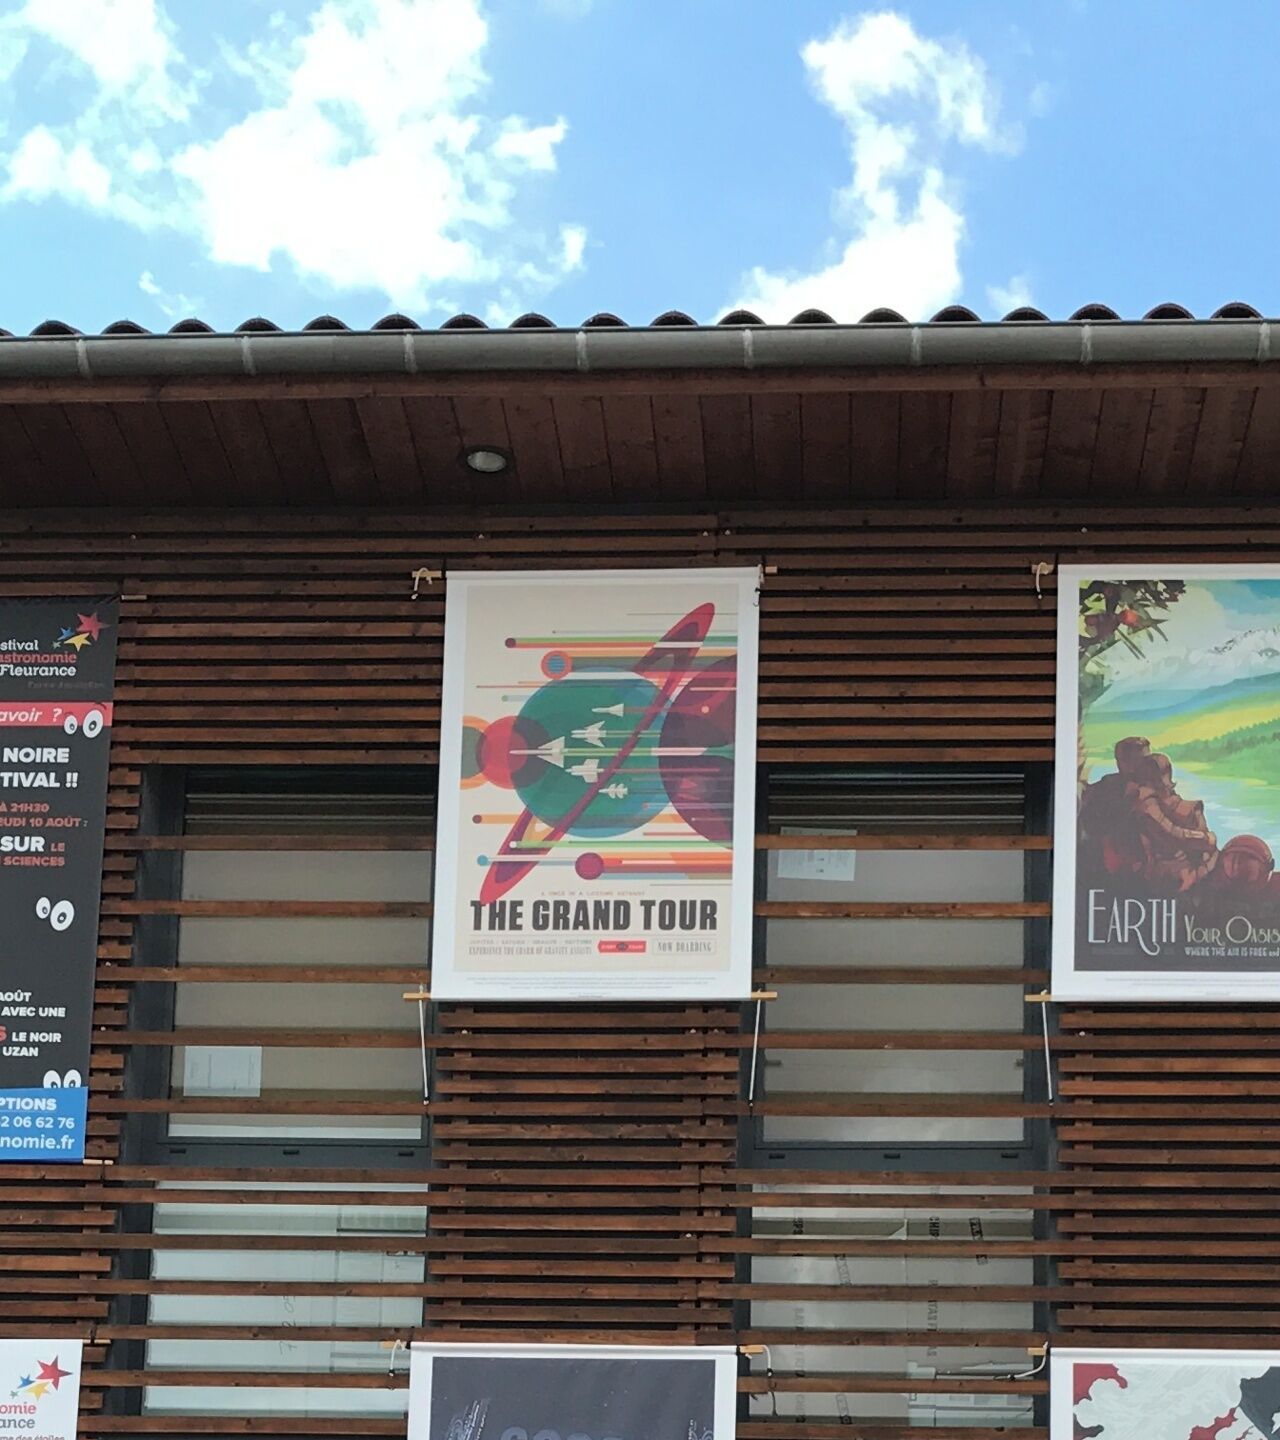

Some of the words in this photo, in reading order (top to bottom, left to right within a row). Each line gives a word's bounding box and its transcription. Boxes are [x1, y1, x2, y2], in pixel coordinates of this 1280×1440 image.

[0, 664, 76, 676] Fleurance
[3, 748, 69, 763] NOIRE
[0, 836, 45, 852] SUR
[51, 843, 65, 852] LE
[4, 857, 65, 866] SCIENCES
[470, 900, 523, 930] THE
[532, 900, 630, 930] GRAND
[640, 900, 717, 930] TOUR
[1185, 947, 1209, 956] WHERE
[1212, 947, 1225, 956] THE
[1227, 948, 1239, 956] AIR
[1241, 948, 1248, 956] IS
[1250, 948, 1266, 956] FREE
[1, 1006, 36, 1017] AVEC
[39, 1007, 66, 1017] UNE
[12, 1033, 26, 1042] LE
[29, 1033, 62, 1042] NOIR
[3, 1047, 38, 1056] UZAN
[13, 1117, 32, 1128] 06
[36, 1118, 54, 1128] 62
[58, 1118, 75, 1128] 76
